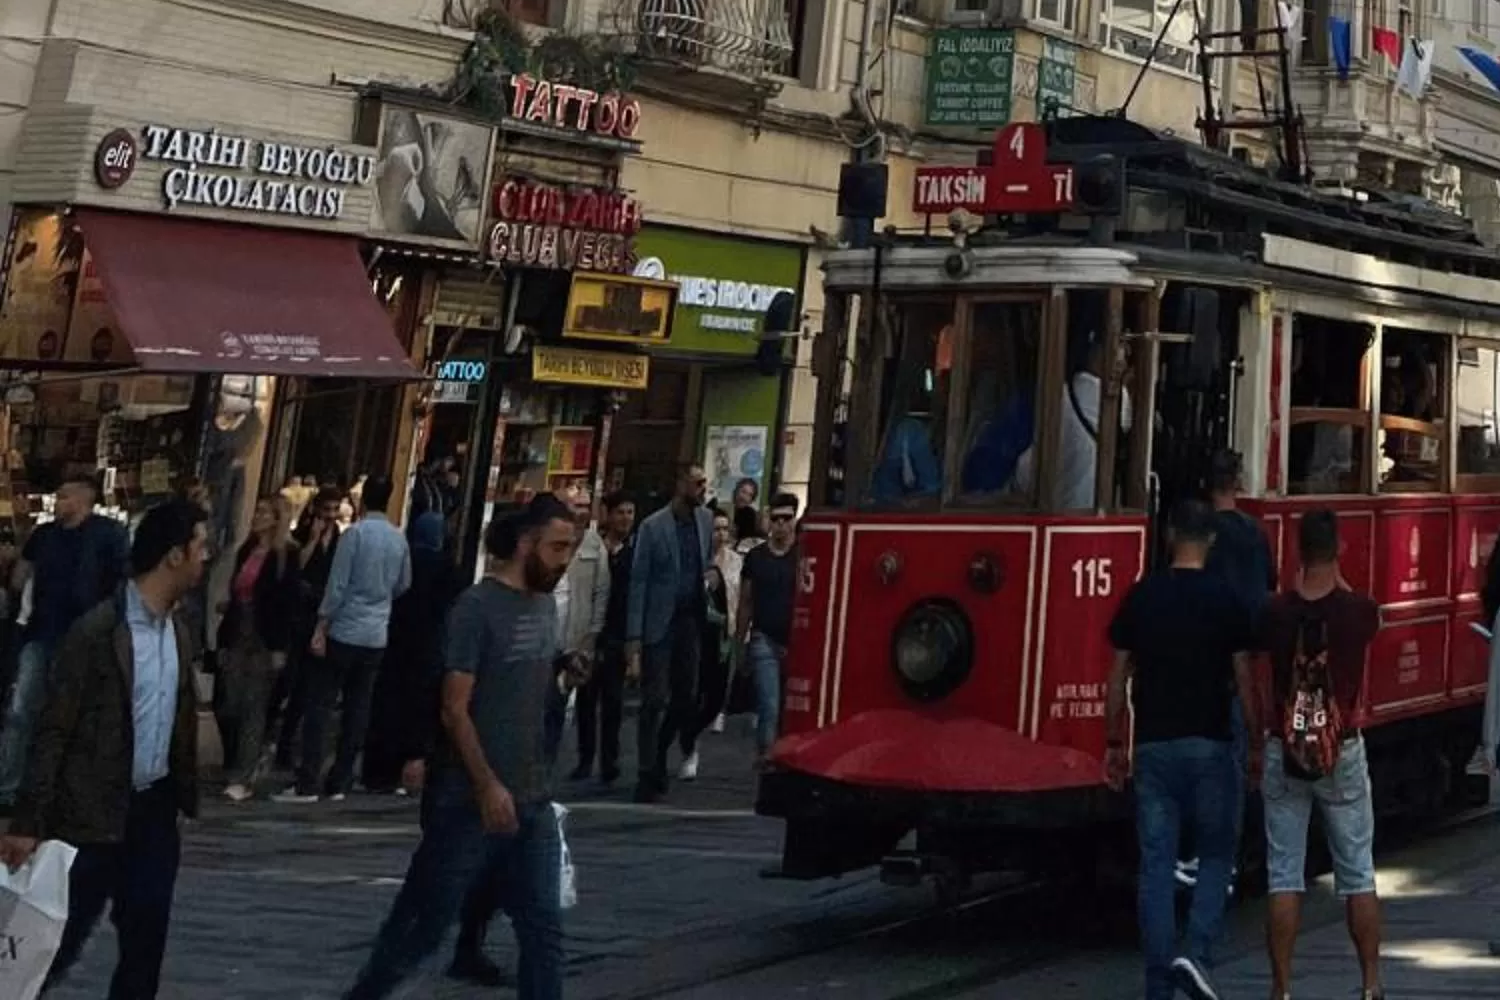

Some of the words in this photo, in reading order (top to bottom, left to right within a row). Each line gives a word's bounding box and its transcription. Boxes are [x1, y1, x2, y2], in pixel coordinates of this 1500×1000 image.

[511, 72, 642, 137] TATTOO
[259, 142, 376, 185] BEYOĞLU
[164, 163, 346, 217] ÇİKOLATACISI
[917, 169, 986, 204] TAKSİM
[490, 221, 560, 269] CLUB
[1071, 558, 1113, 597] 115
